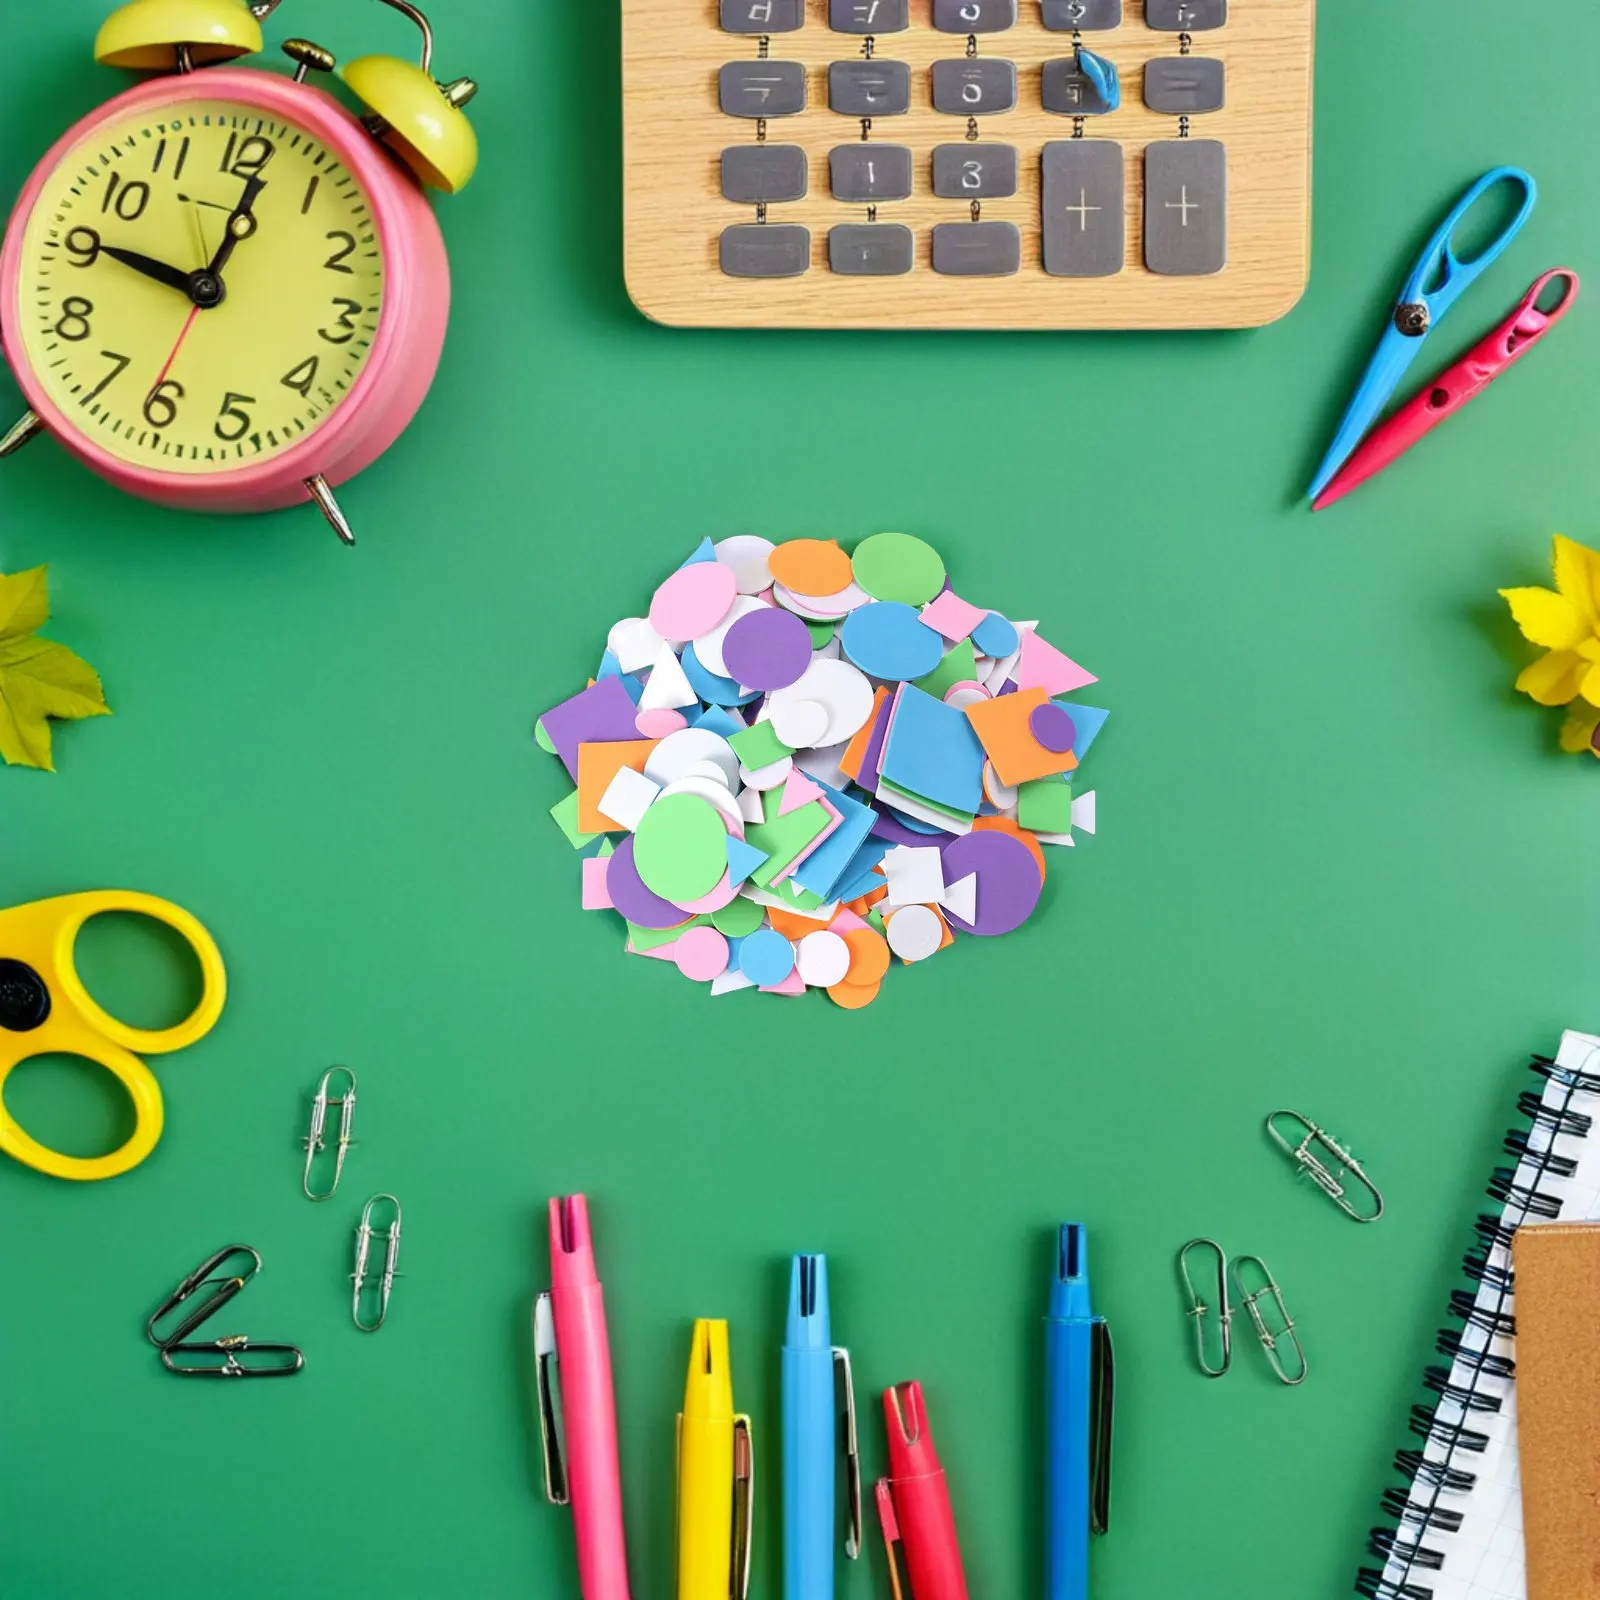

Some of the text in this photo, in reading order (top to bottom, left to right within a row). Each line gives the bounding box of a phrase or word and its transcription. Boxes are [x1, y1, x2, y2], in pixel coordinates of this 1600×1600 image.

[152, 136, 190, 180] 11
[219, 132, 276, 180] 12
[101, 172, 151, 221] 10
[301, 176, 319, 215] 1
[65, 225, 101, 268] 9
[323, 231, 357, 274] 2
[55, 296, 94, 341] 8
[318, 297, 363, 344] 3
[80, 350, 131, 402] 7
[280, 355, 320, 400] 4
[143, 379, 185, 428] 6
[214, 392, 256, 442] 5
